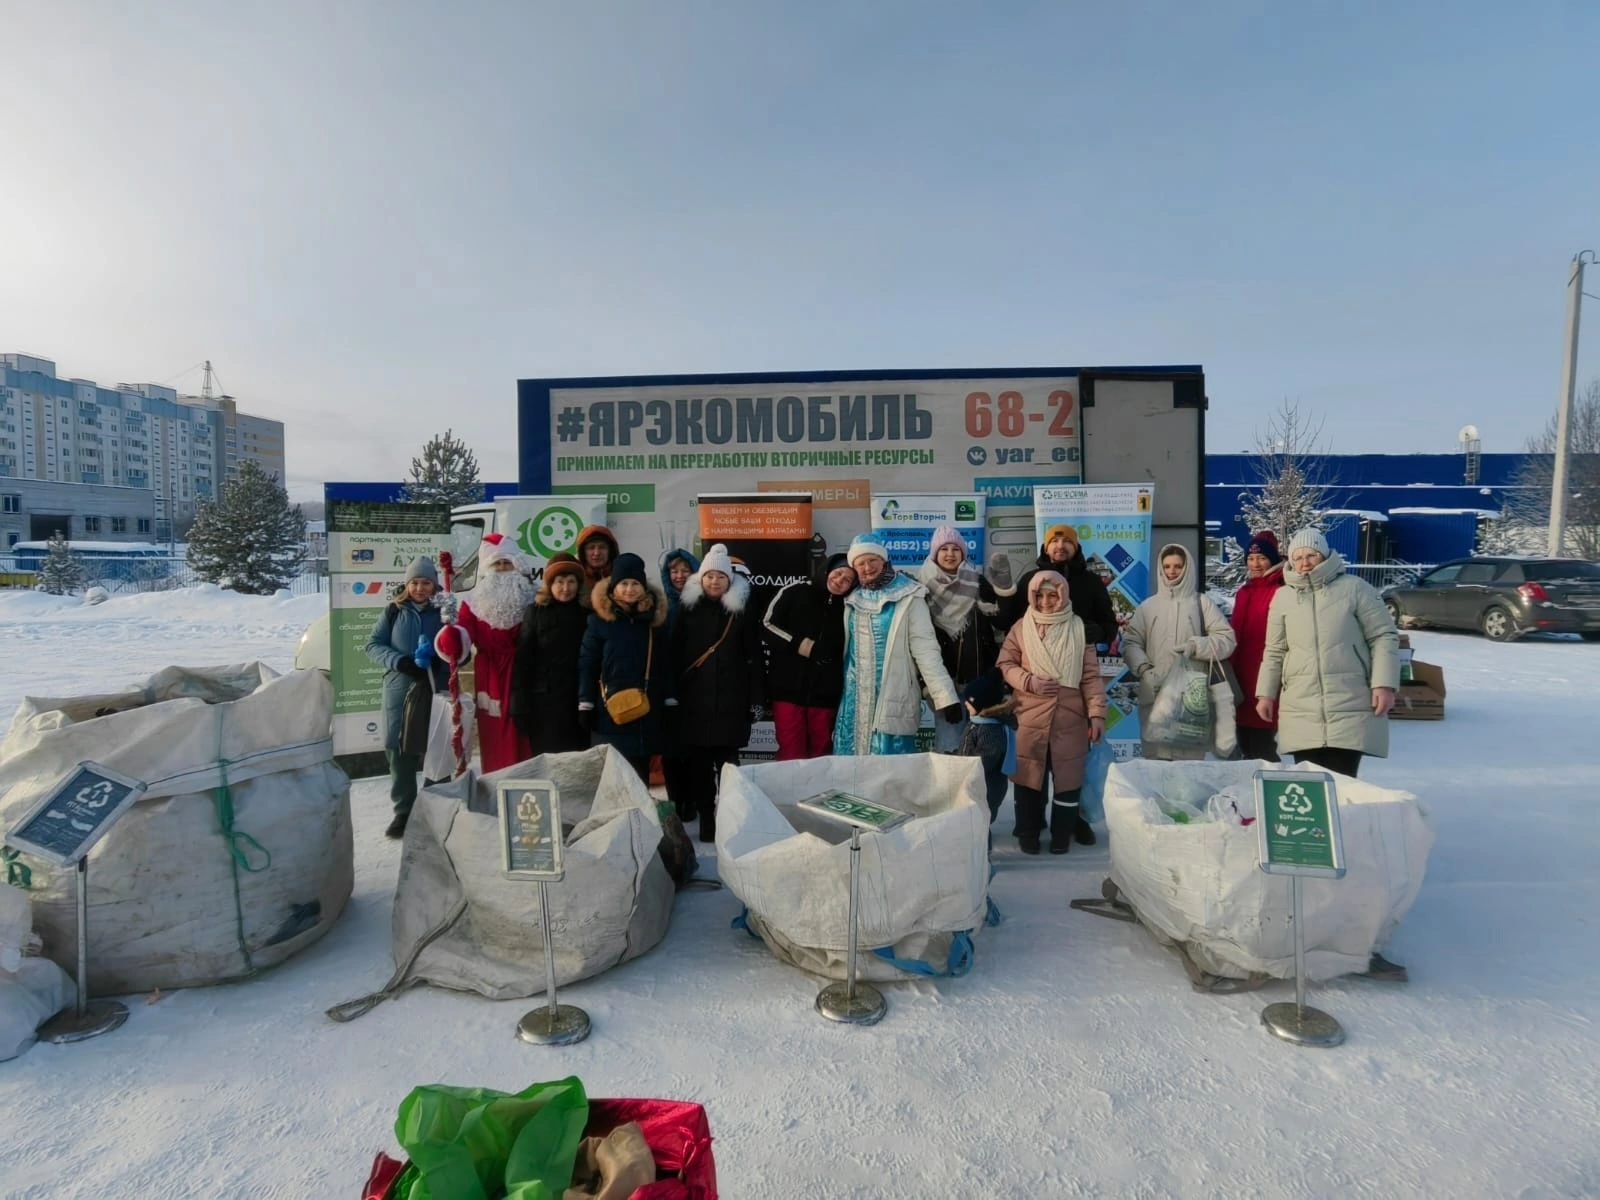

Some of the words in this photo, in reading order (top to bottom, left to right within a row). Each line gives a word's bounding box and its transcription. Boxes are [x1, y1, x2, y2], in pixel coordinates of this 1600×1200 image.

[557, 394, 933, 446] #ЯРЭКОМОБИЛЬ
[965, 390, 1073, 438] 68-2
[557, 455, 645, 472] ПРИНИМАЕМ
[649, 454, 668, 470] НА
[671, 453, 768, 469] ПЕРЕРАБОТКУ
[771, 450, 862, 468] ВТОРИЧНЫЕ
[865, 449, 934, 465] РЕСУРСЫ
